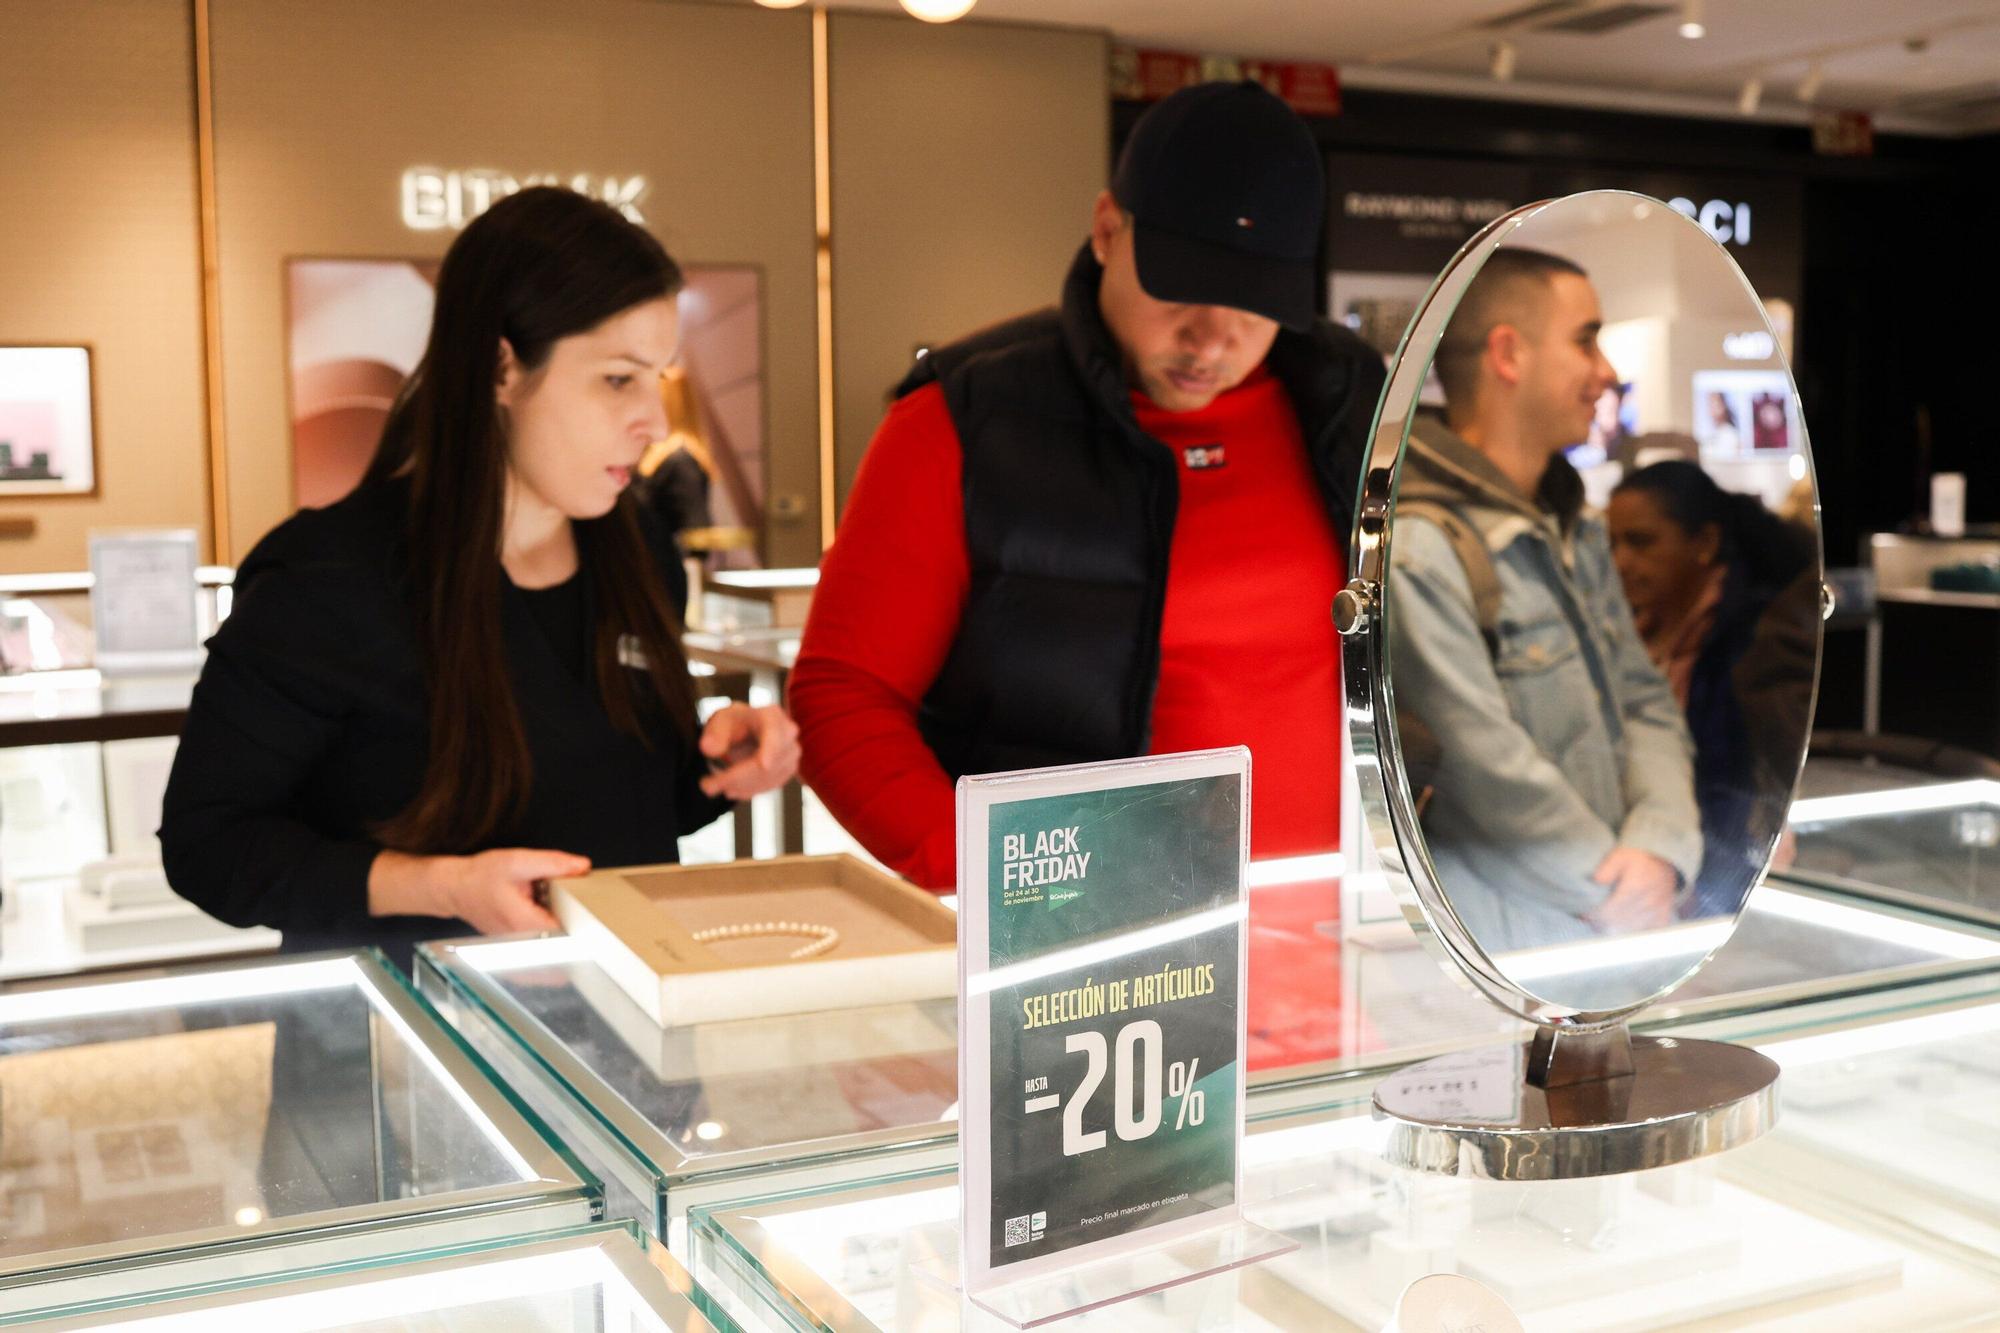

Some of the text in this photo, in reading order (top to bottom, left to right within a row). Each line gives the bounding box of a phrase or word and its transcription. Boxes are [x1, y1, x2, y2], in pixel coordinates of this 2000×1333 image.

[1004, 826, 1079, 861] BLACK
[1004, 852, 1091, 889] FRIDAY
[1023, 962, 1215, 1030] SELECCIÓN DE ARTÍCULOS
[1025, 1076, 1048, 1093] HASTA
[1080, 1193, 1189, 1226] Precio final marcado en etiqueta
